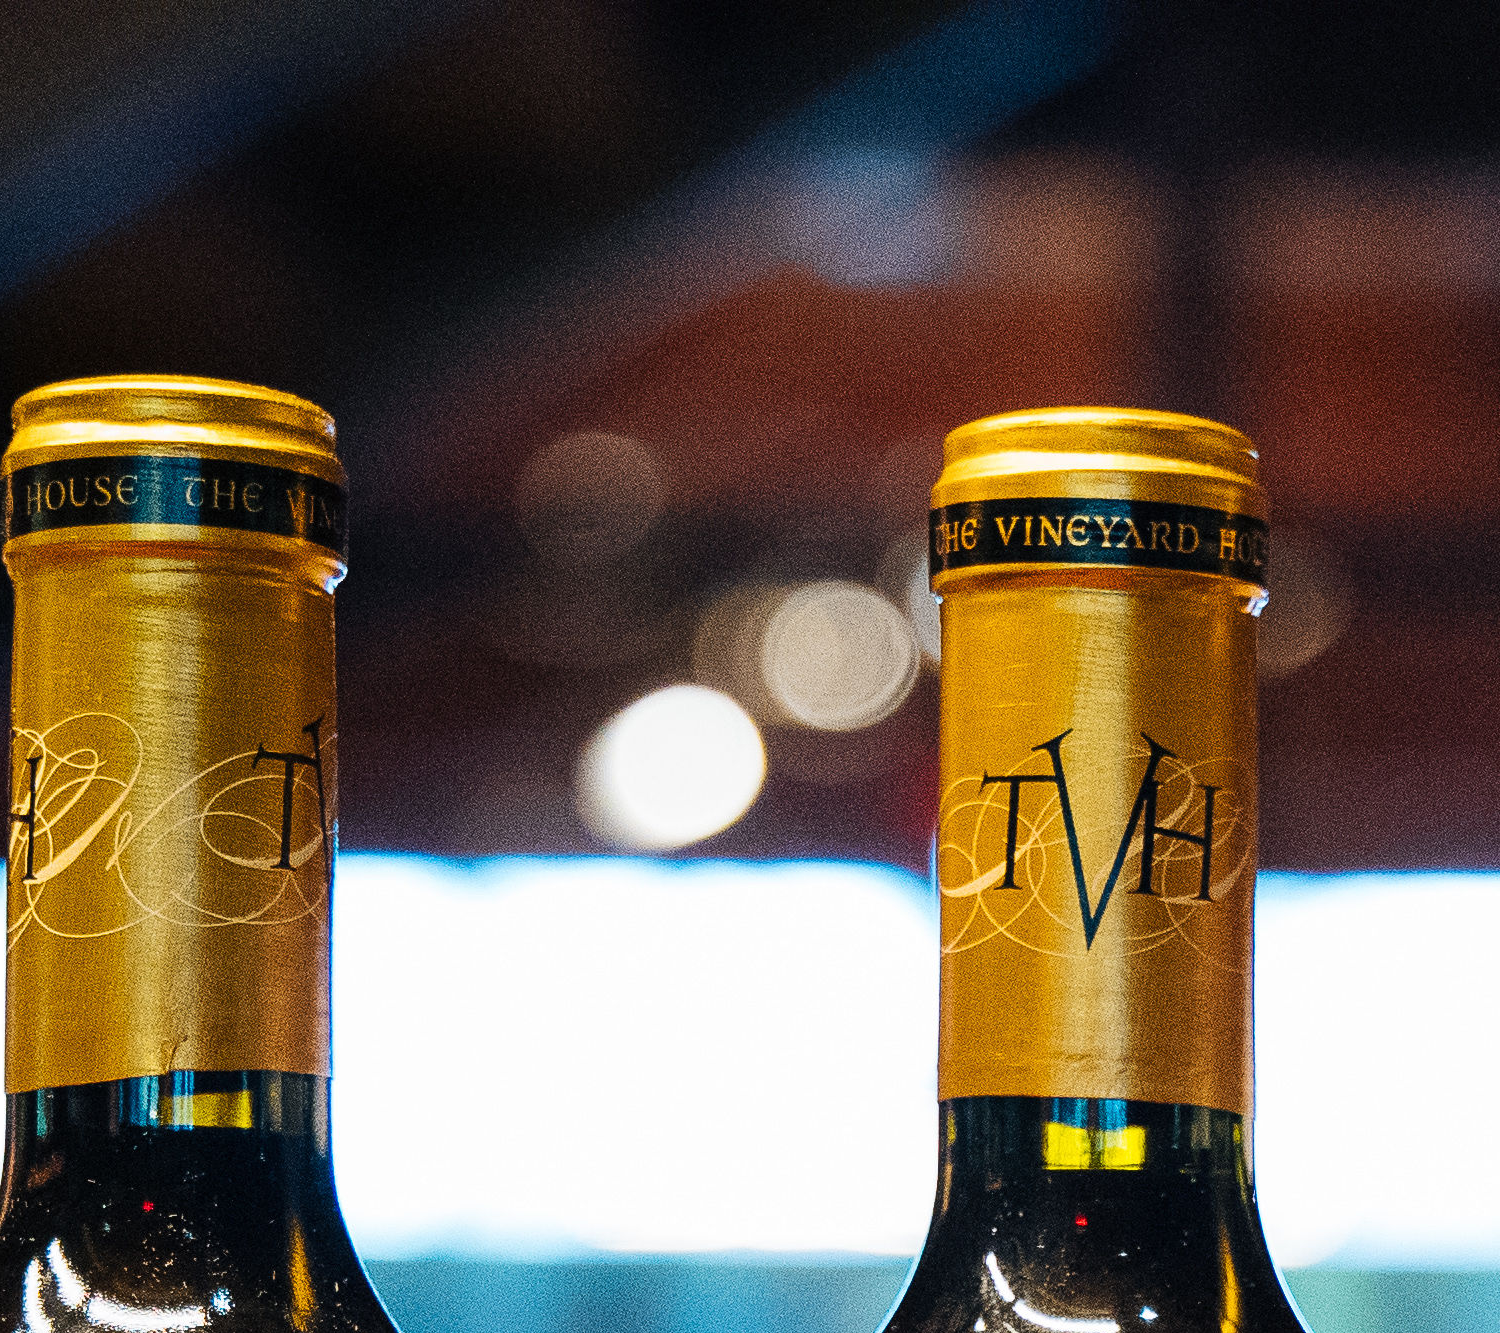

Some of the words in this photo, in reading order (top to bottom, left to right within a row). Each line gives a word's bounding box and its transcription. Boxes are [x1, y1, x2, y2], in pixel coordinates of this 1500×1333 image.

[27, 475, 139, 515] HOUSE
[183, 476, 264, 512] THE
[994, 514, 1200, 553] VINEYARD
[979, 728, 1221, 952] TVH
